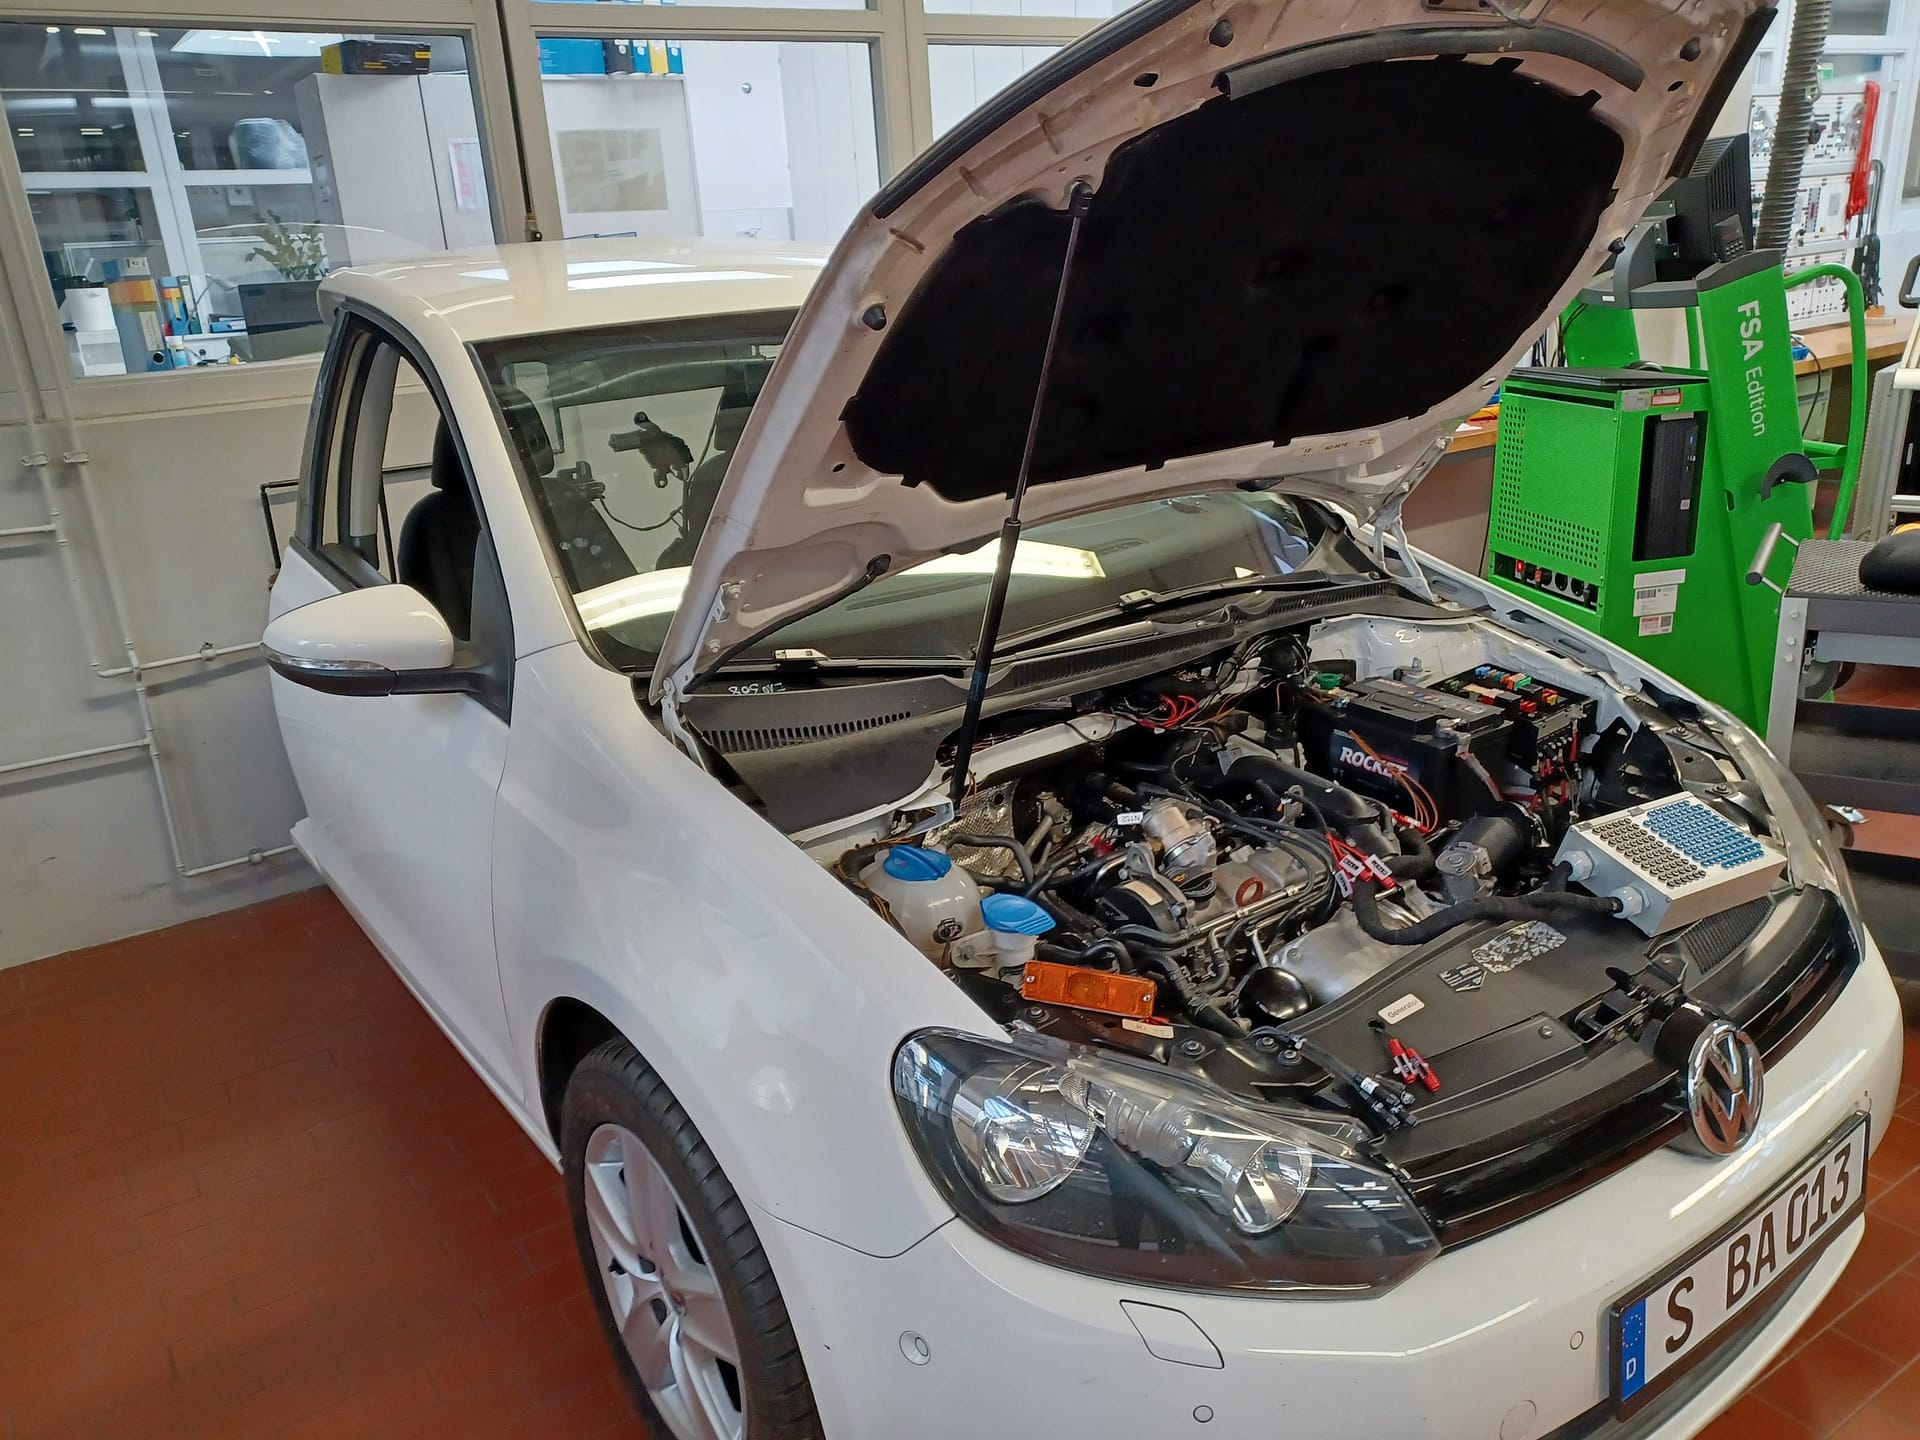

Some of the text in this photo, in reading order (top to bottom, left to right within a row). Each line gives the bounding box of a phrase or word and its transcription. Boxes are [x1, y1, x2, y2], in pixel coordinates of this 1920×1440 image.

[1737, 300, 1767, 437] FSA Edition
[1665, 1275, 1694, 1354] S
[1625, 1357, 1637, 1381] D
